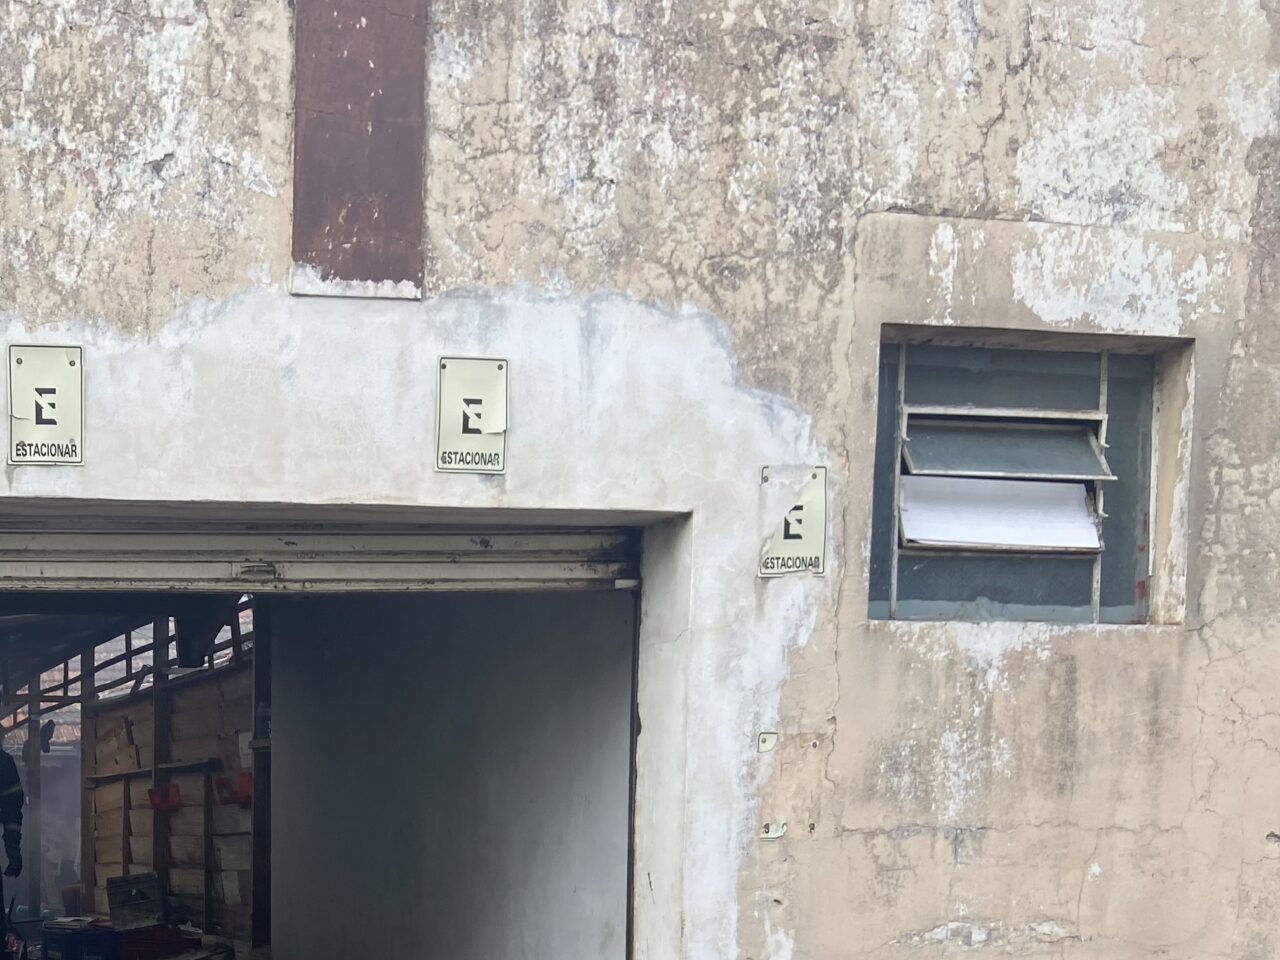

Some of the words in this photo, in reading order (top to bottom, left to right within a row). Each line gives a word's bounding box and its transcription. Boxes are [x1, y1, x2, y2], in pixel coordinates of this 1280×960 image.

[15, 442, 78, 458] ESTACIONAR
[441, 451, 500, 466] ESTACIONAR
[762, 556, 820, 570] ESTACIONAR
